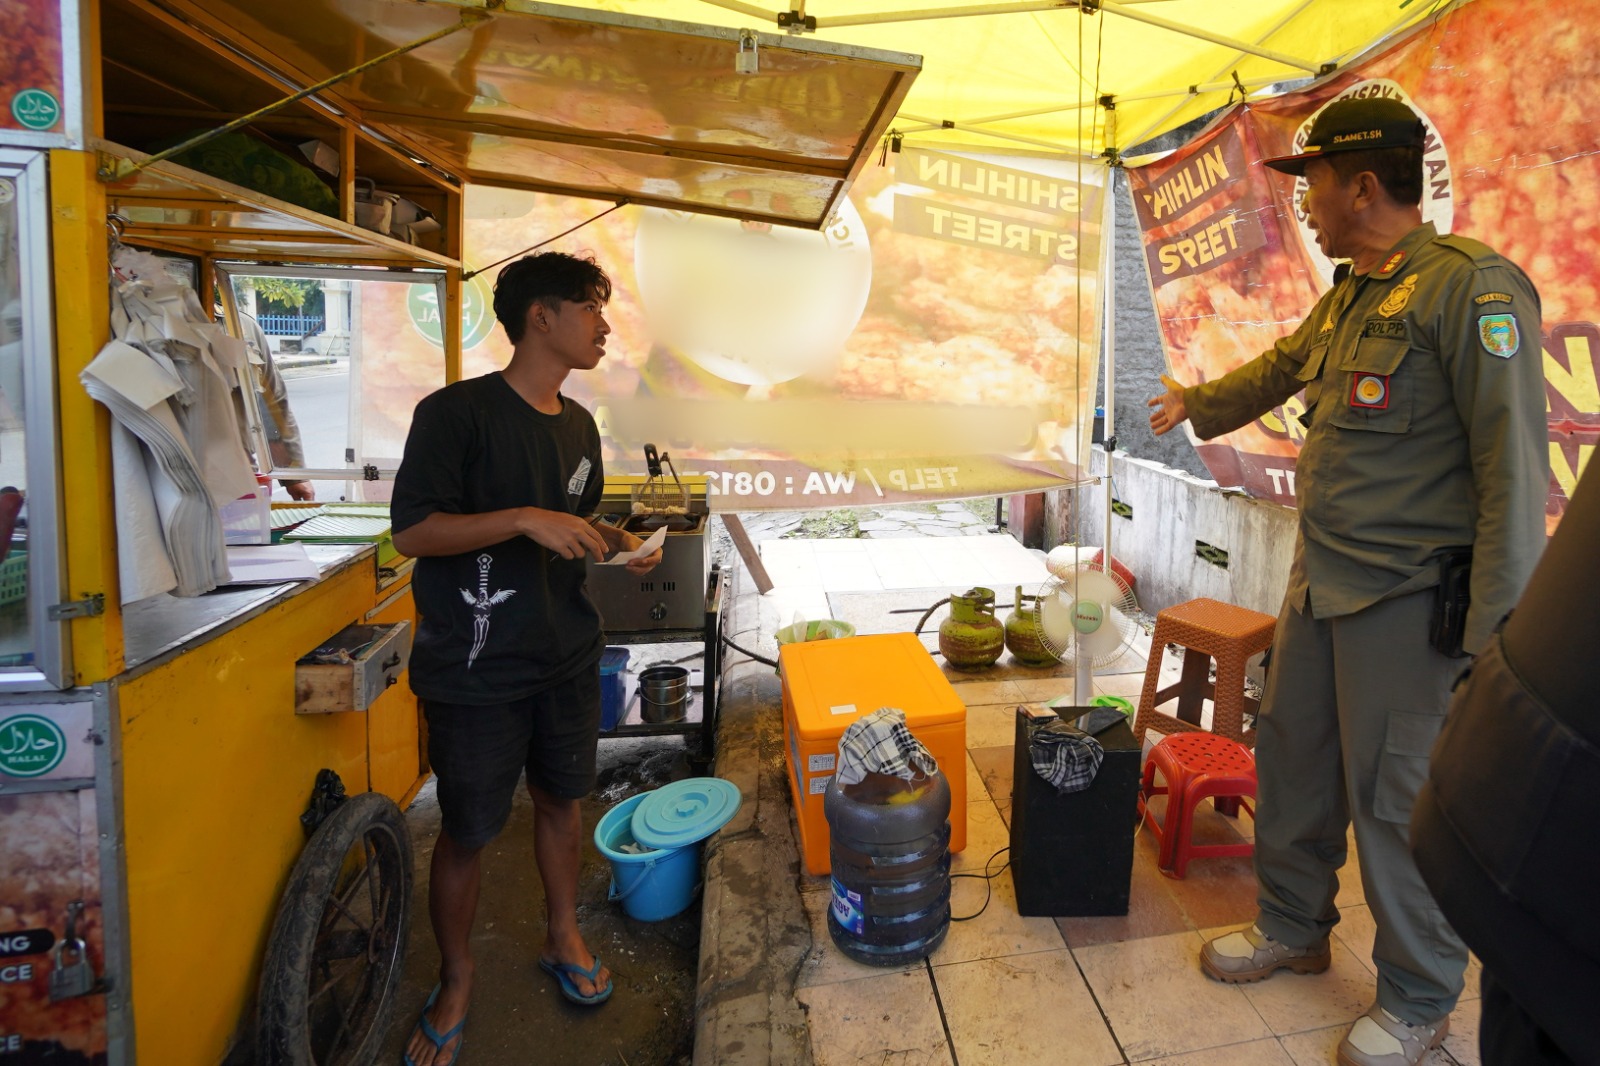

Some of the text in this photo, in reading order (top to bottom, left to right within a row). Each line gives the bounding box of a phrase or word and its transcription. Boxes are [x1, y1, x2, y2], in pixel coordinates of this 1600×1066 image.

[1333, 129, 1382, 144] SLAMET.SH
[1368, 322, 1404, 335] POL PP
[0, 725, 56, 755] حلال
[8, 755, 48, 764] HALAL
